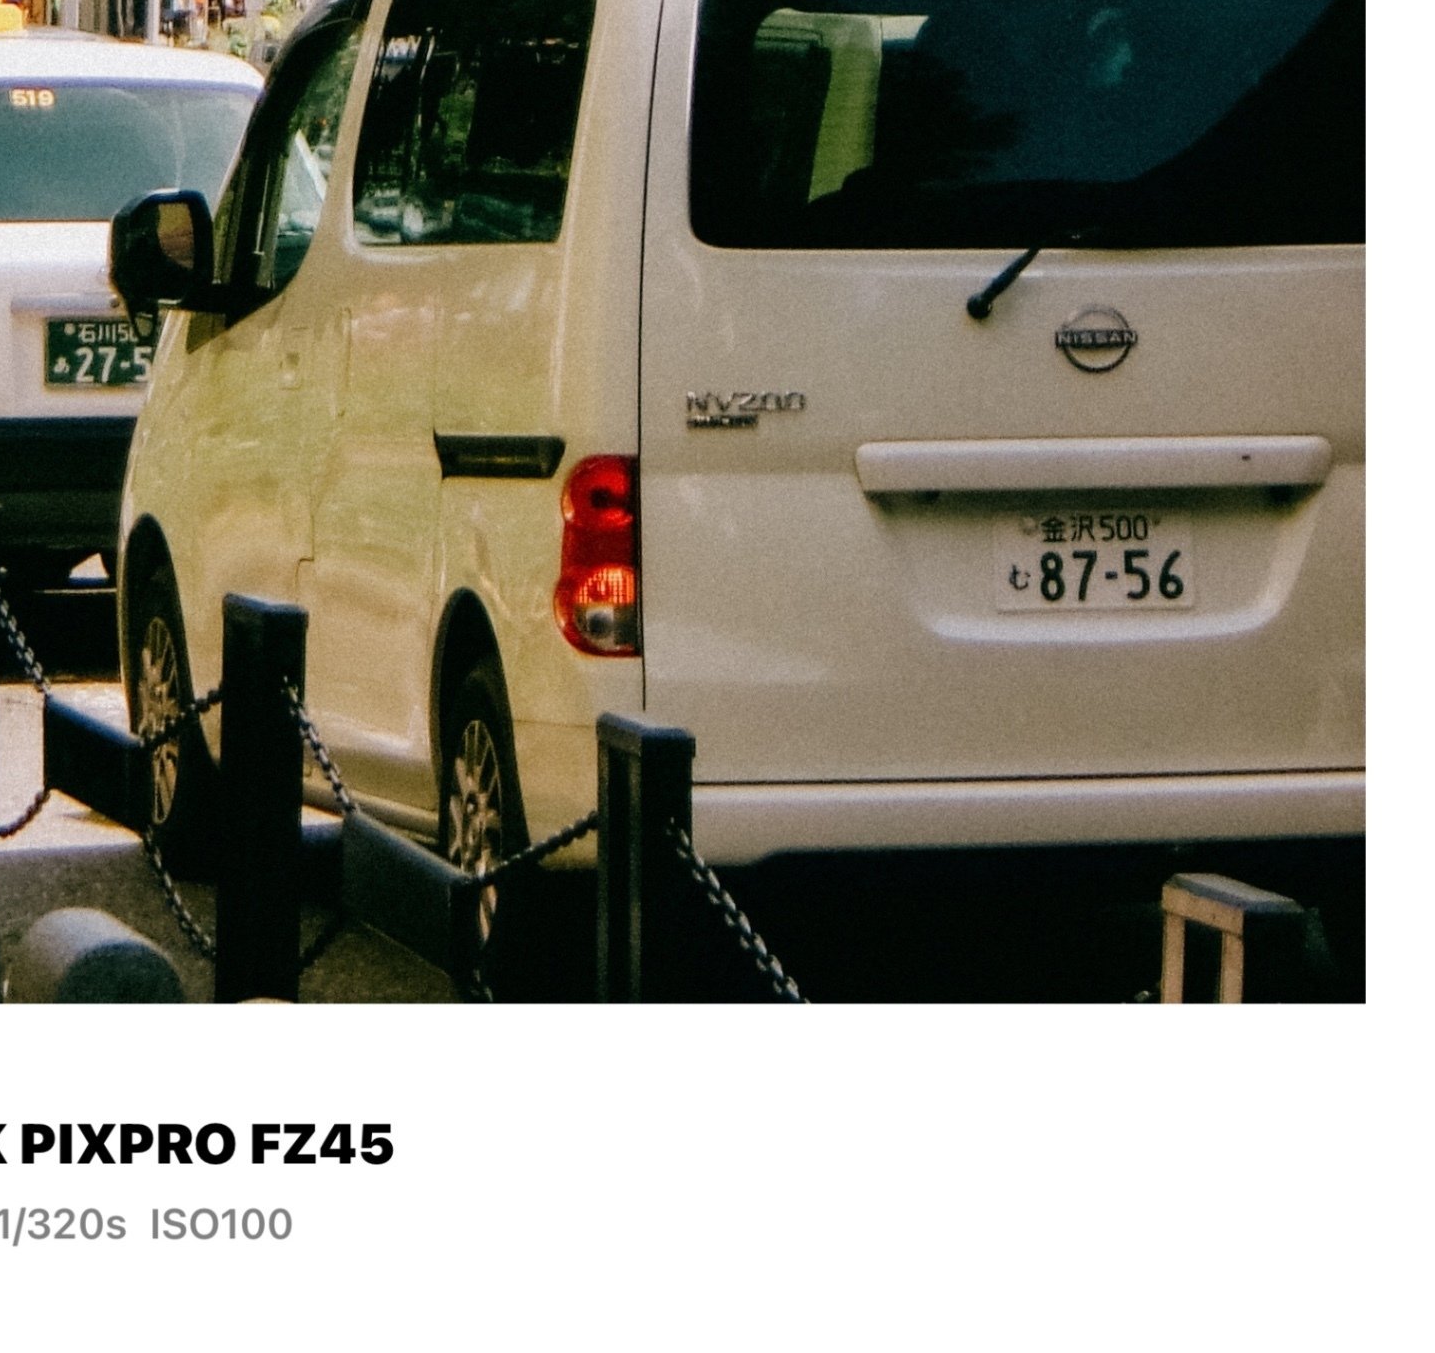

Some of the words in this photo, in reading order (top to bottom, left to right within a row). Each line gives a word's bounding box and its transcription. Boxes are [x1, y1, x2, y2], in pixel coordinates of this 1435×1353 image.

[11, 87, 56, 107] 519
[1056, 329, 1138, 348] NISSAN
[1040, 514, 1149, 544] 金沢500
[1039, 549, 1186, 602] 87-56
